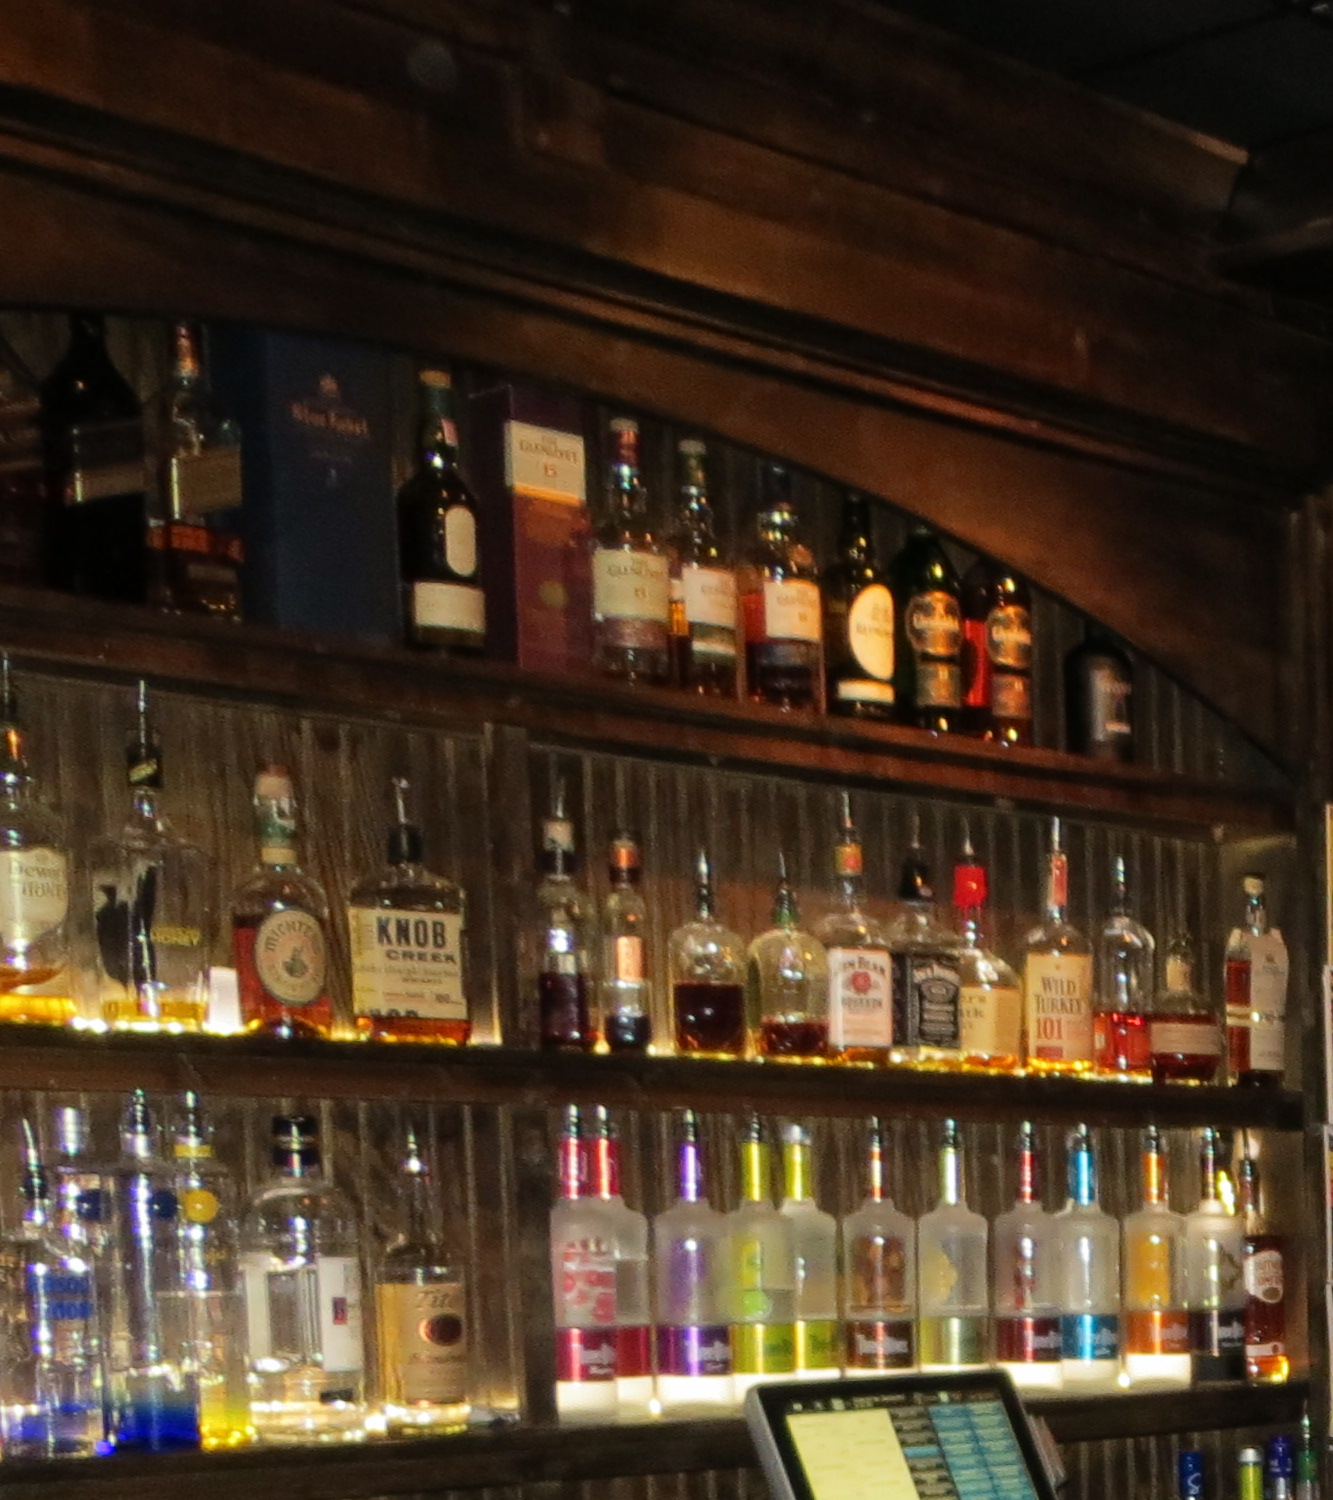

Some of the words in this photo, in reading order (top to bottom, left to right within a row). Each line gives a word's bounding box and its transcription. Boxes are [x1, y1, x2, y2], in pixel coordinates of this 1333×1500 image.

[376, 916, 447, 949] KNOB
[386, 949, 458, 966] CREEK
[1041, 976, 1077, 997] WILD
[1035, 995, 1085, 1015] TURKEY
[1037, 1018, 1063, 1040] 101
